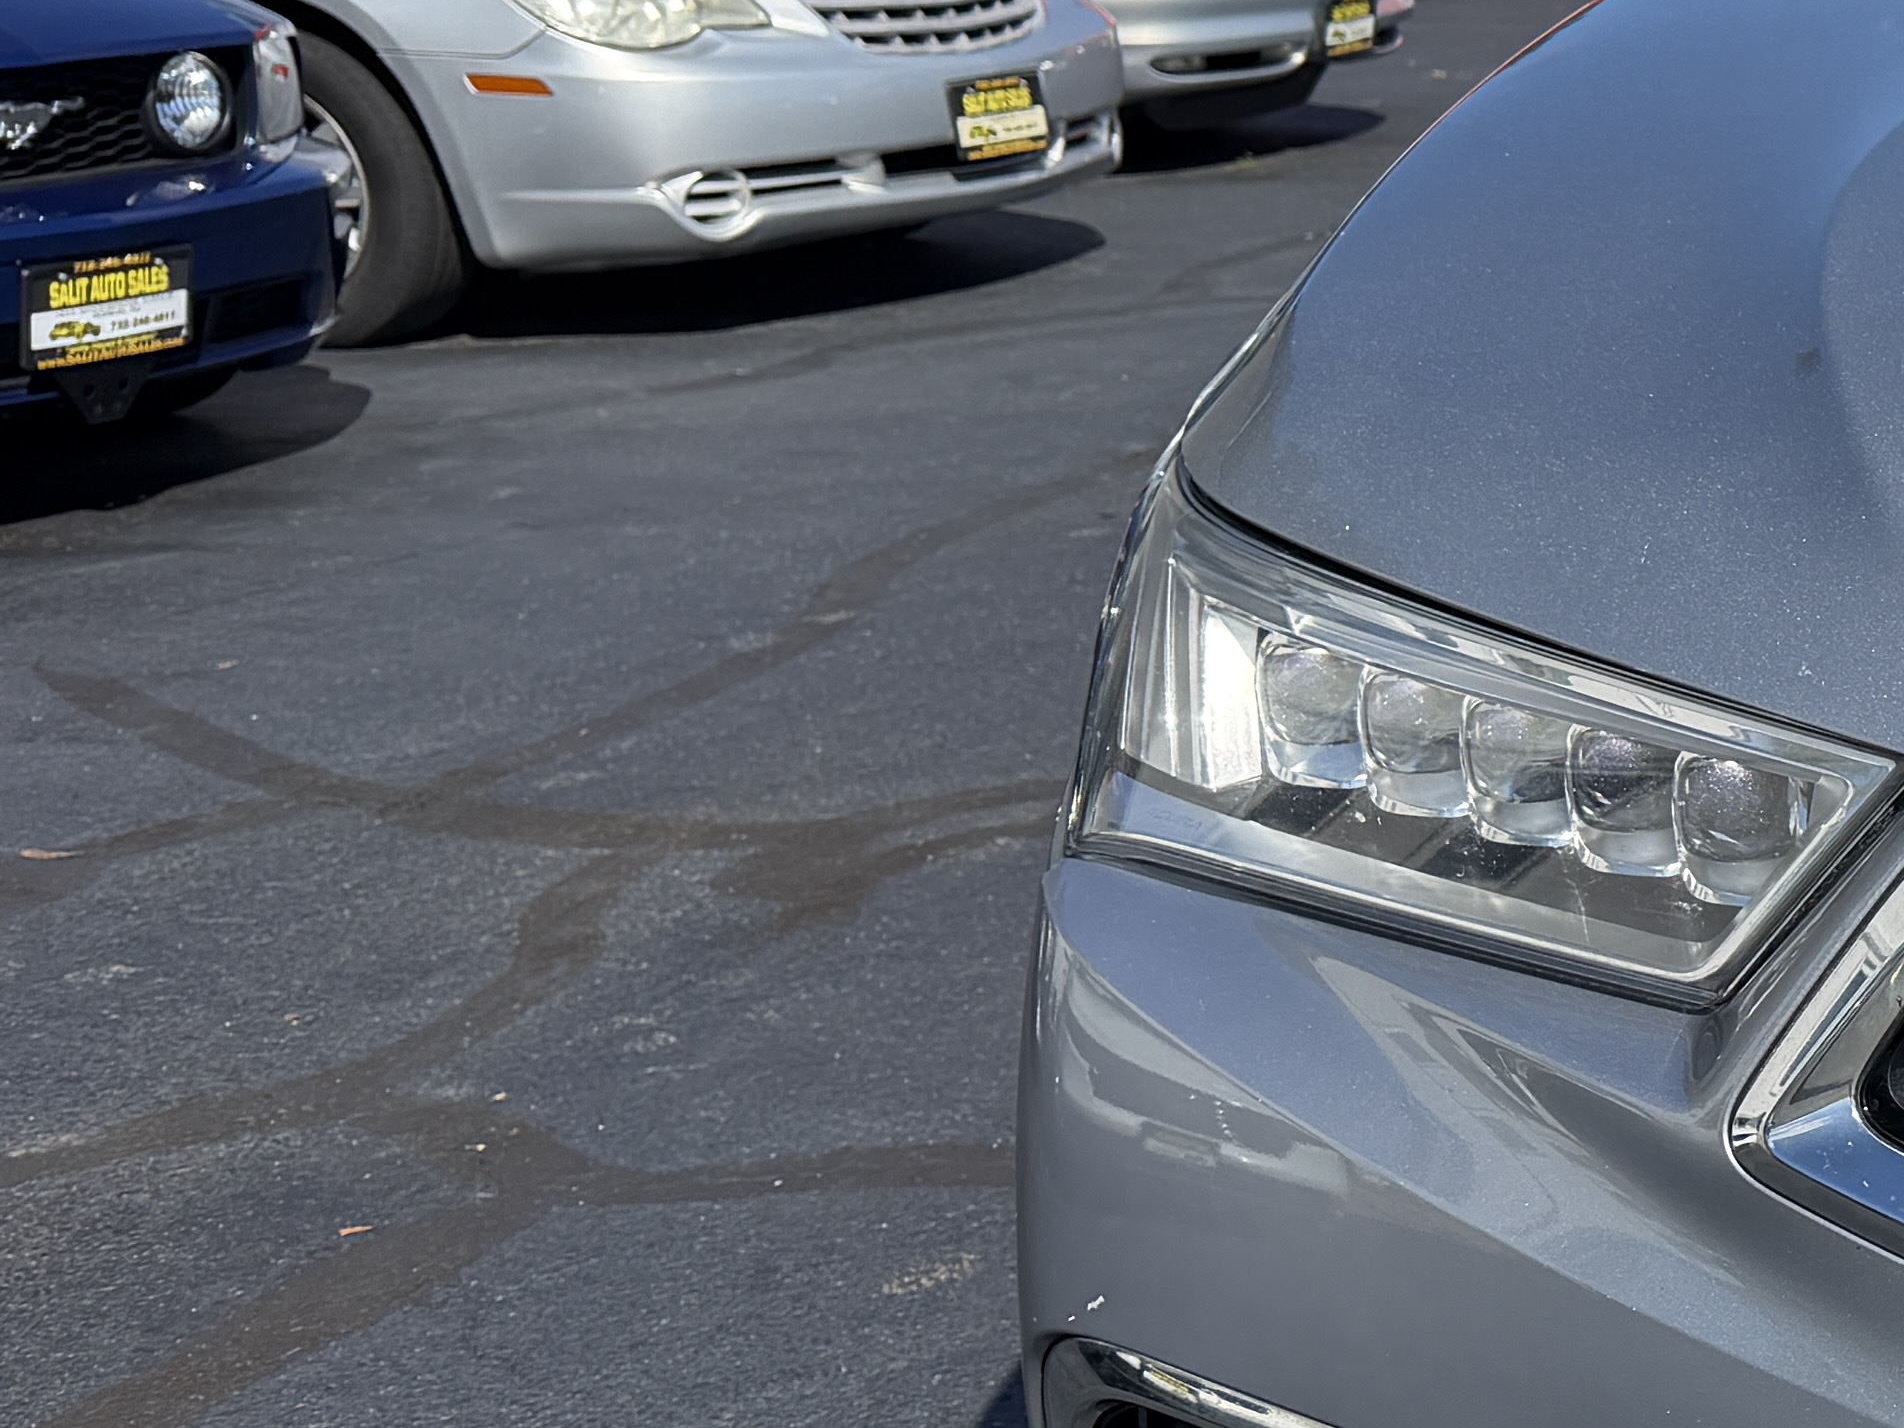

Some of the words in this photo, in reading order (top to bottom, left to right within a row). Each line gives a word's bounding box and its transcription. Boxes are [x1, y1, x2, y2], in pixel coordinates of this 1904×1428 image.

[49, 277, 89, 310] SALIT
[90, 271, 126, 303] AUTO
[128, 264, 170, 297] SALES
